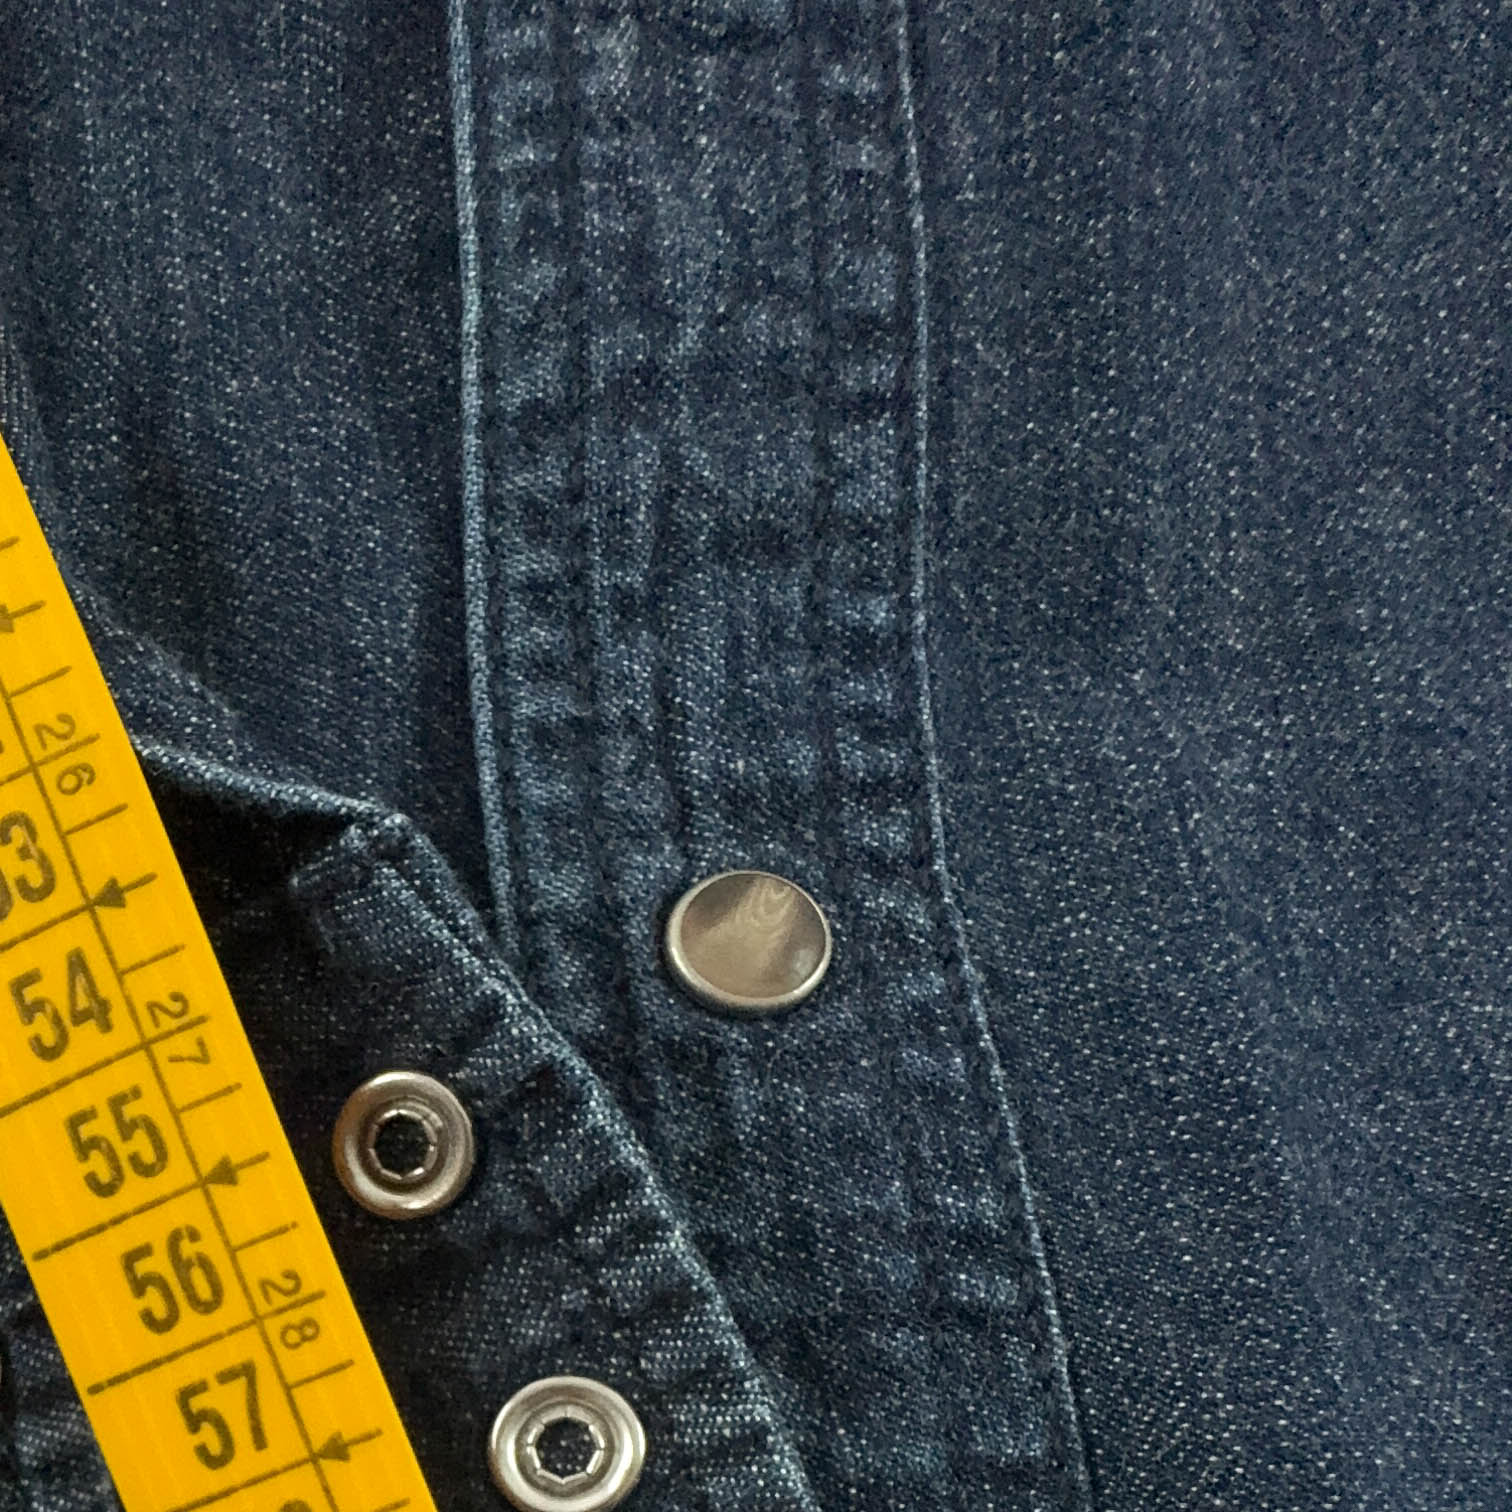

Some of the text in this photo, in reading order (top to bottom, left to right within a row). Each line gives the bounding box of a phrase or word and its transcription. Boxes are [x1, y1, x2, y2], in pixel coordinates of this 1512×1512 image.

[33, 714, 96, 796] 26
[8, 946, 115, 1063] 54
[146, 991, 210, 1066] 27
[64, 1085, 169, 1199] 55
[120, 1225, 225, 1335] 56
[259, 1269, 321, 1350] 28
[175, 1360, 269, 1471] 57
